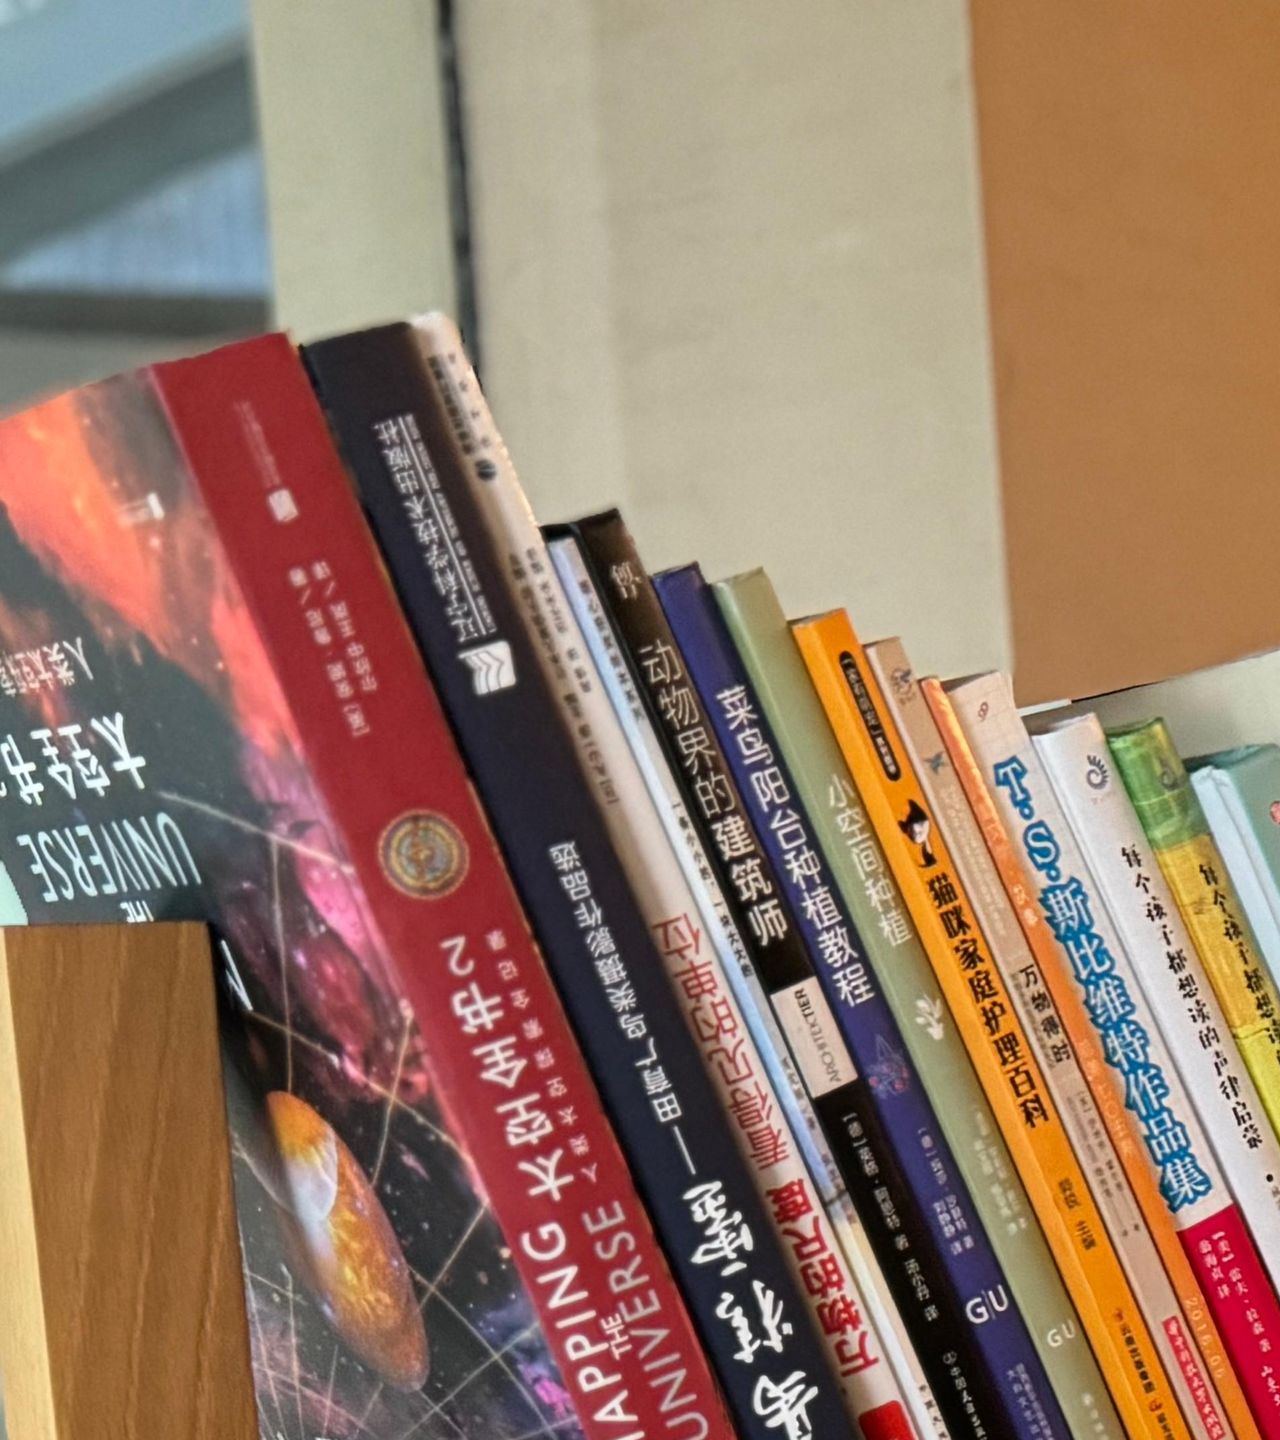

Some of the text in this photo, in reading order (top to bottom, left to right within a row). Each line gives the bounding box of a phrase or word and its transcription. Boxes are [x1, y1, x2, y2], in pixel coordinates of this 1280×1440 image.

[371, 421, 478, 643] 辽宁科学技术出版社
[0, 712, 145, 805] 太空全书
[16, 811, 202, 903] UNIVERSE
[639, 641, 786, 947] 动物界的建筑师
[716, 683, 877, 1010] 菜鸟阳台种植教程
[828, 772, 912, 948] 小空间种植
[441, 935, 577, 1203] 太空全书2
[486, 928, 602, 1184] 人类太空探索全记录
[551, 838, 687, 1124] 田育广鸟类摄影作品选
[652, 910, 791, 1171] 看得见的单位
[927, 876, 1049, 1128] 猫咪家庭护理百科
[994, 756, 1213, 1213] T.S.斯比维特作品集
[1121, 846, 1263, 1148] 每个孩子都想读的声律启蒙
[600, 1315, 625, 1361] THE
[765, 1177, 881, 1378] 万物的尺度
[1047, 1320, 1077, 1349] GU
